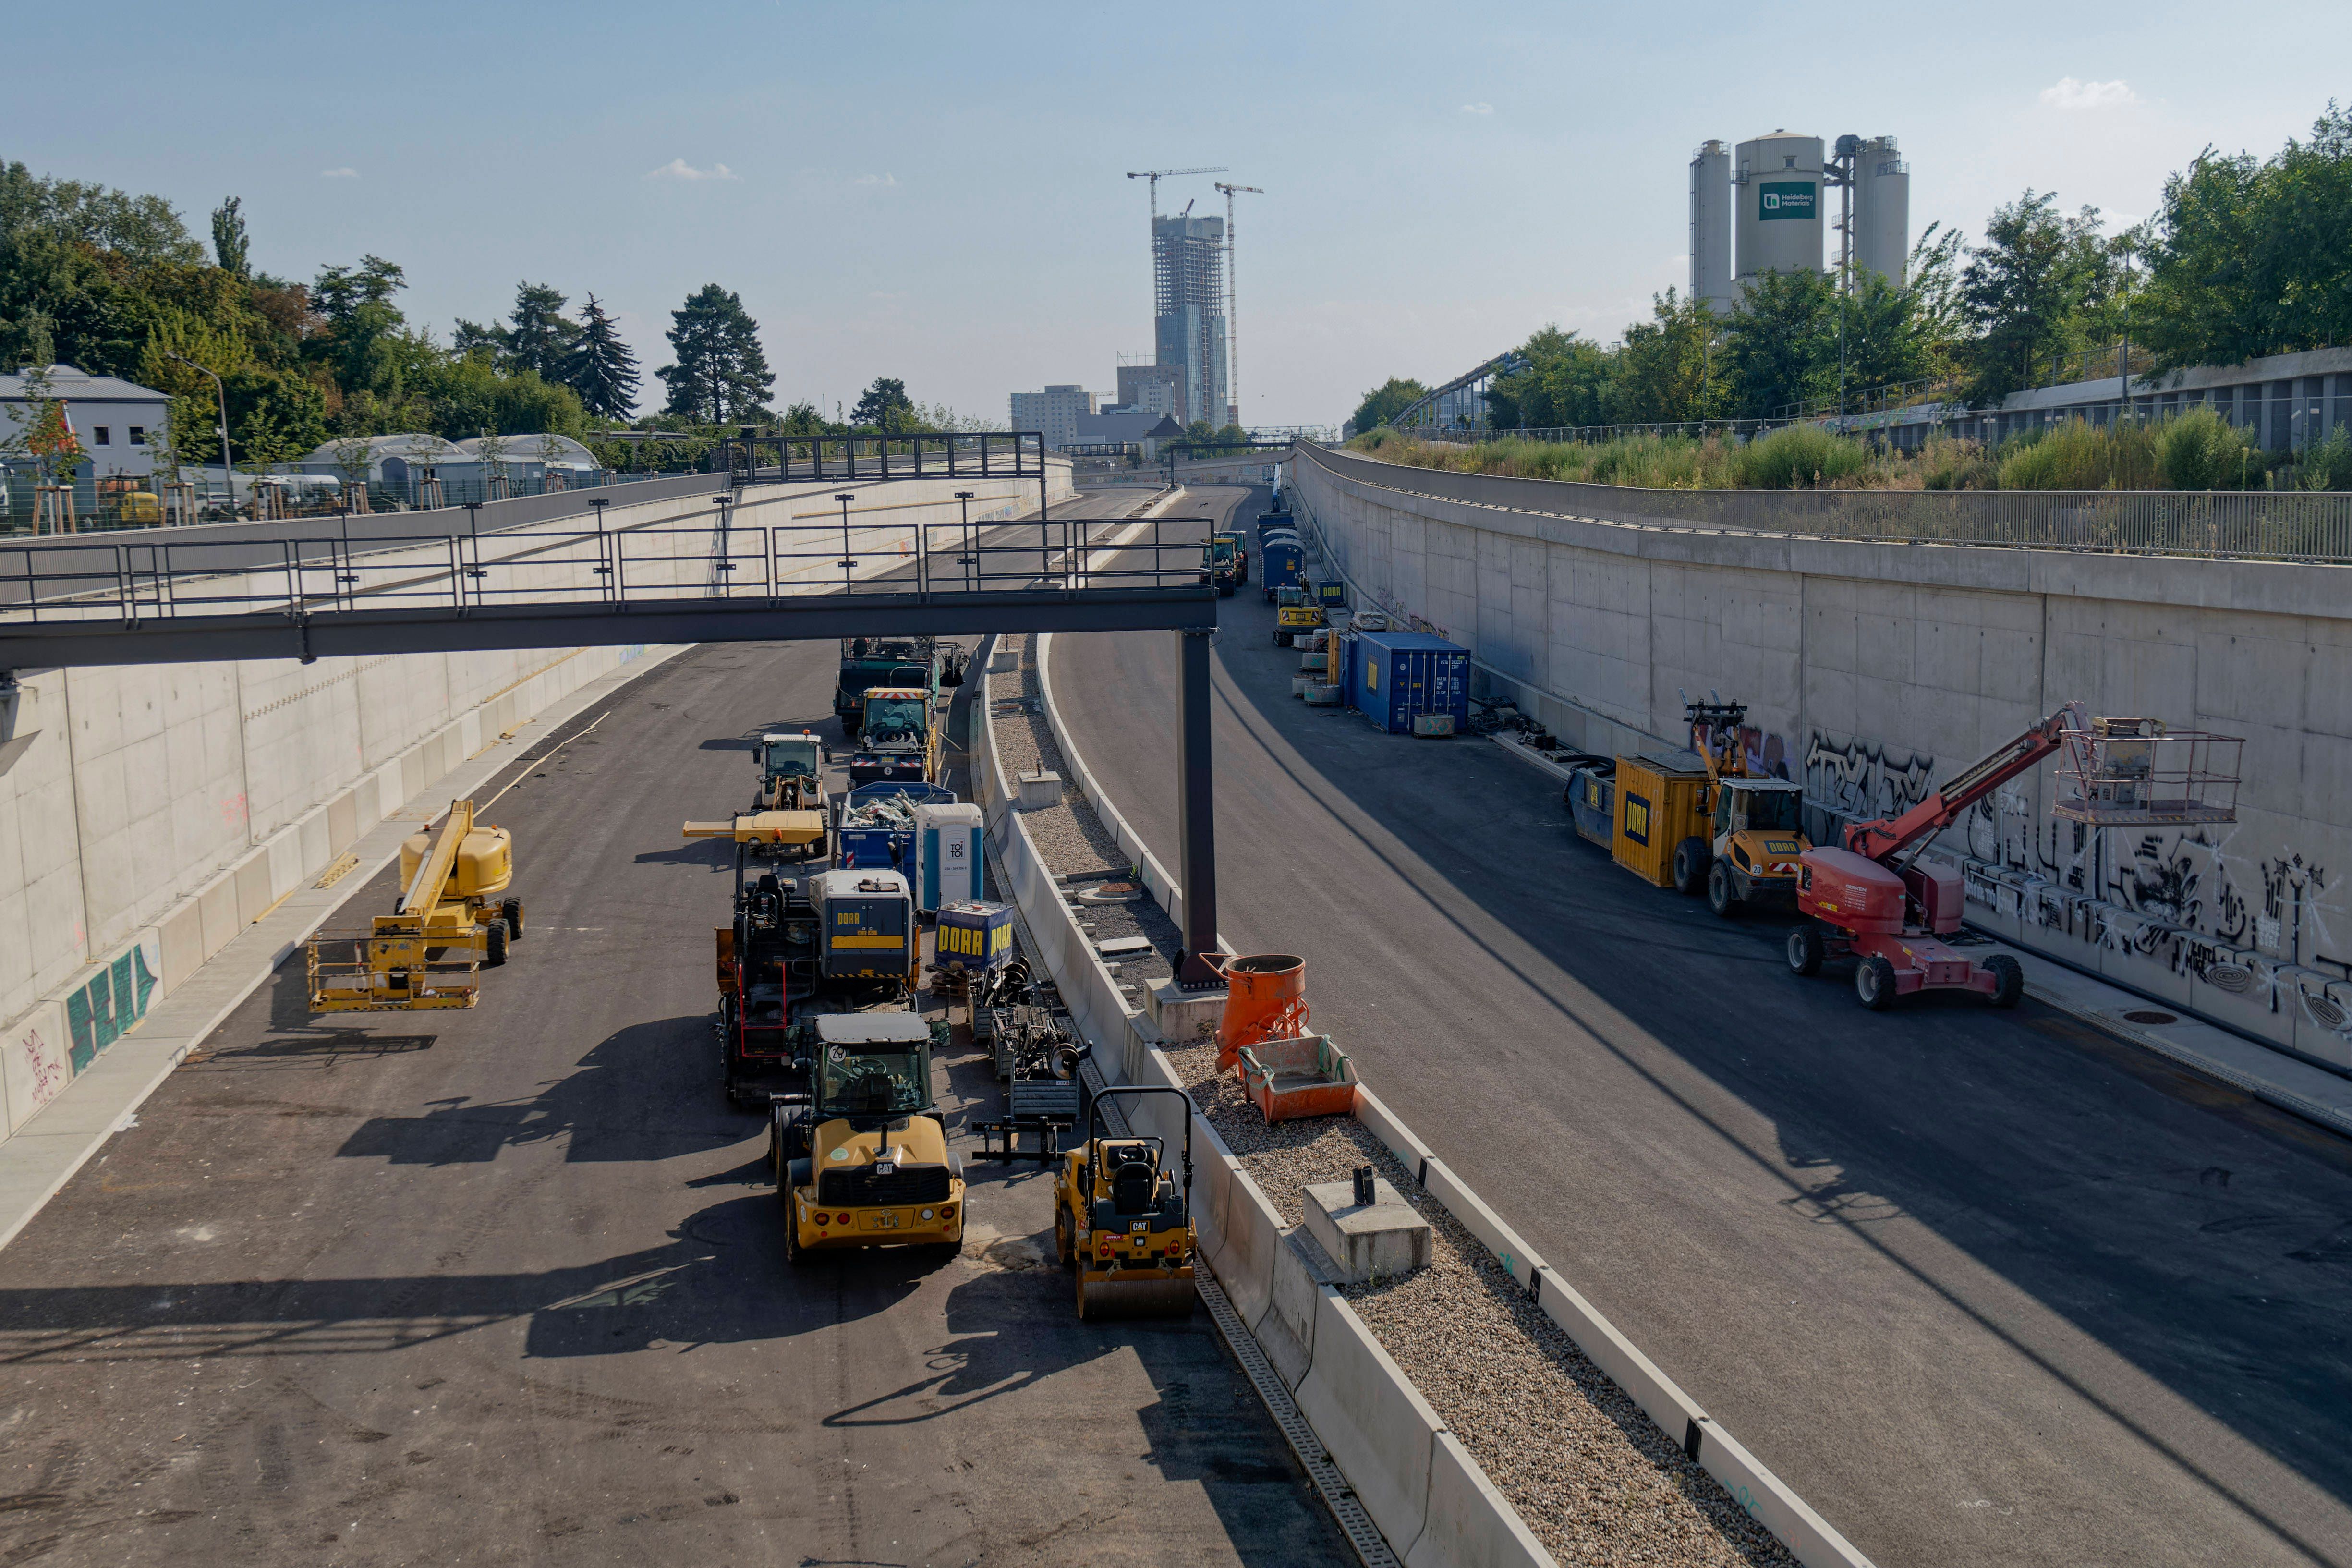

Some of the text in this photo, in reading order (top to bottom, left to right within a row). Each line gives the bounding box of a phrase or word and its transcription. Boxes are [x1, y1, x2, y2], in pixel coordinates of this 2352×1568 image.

[1627, 801, 1647, 838] PORR
[1768, 842, 1797, 852] PORR
[1845, 884, 1867, 892] GERKEN
[837, 912, 860, 925] PORR
[938, 925, 983, 956] PORR
[876, 1163, 894, 1175] CAT
[1133, 1222, 1147, 1231] CAT
